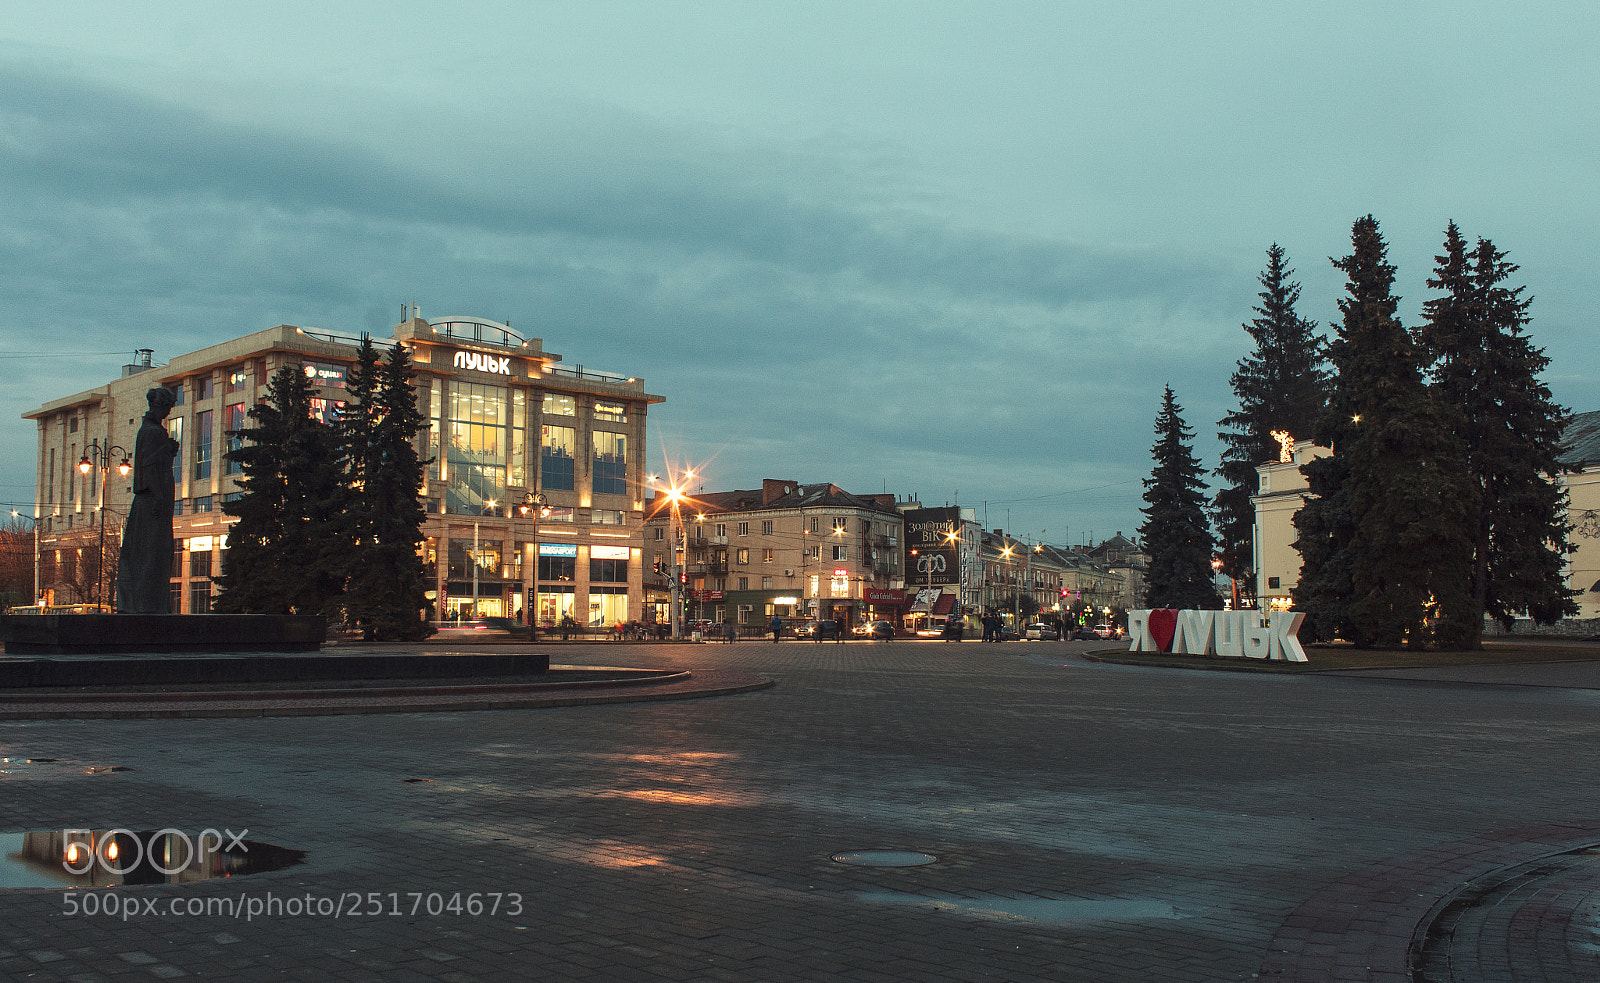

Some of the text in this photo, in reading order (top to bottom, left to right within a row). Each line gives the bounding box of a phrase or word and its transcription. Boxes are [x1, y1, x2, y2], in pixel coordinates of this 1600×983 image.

[453, 351, 510, 375] ЛУЦЬК
[1128, 609, 1308, 662] Я ЛУЦЬК
